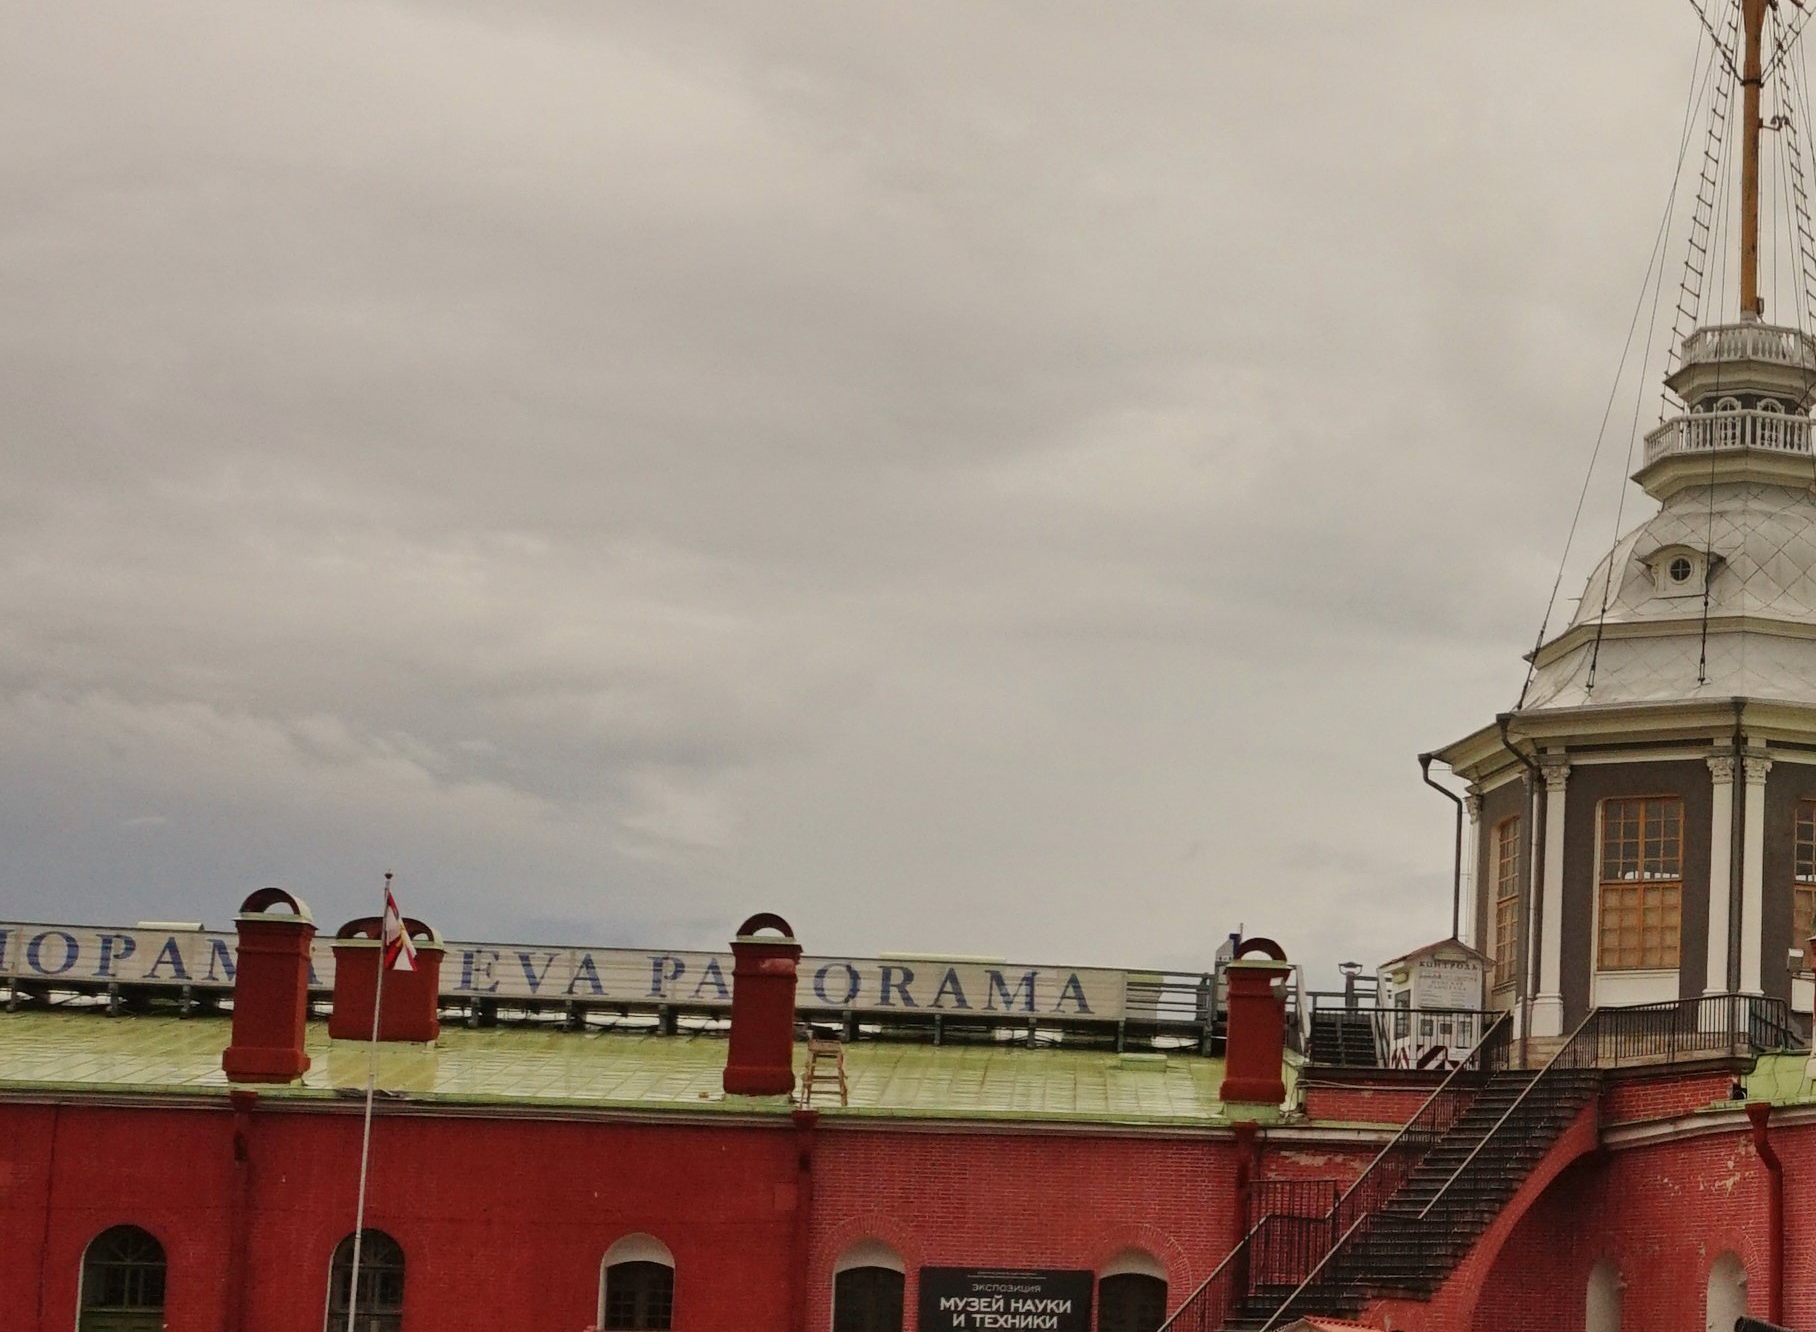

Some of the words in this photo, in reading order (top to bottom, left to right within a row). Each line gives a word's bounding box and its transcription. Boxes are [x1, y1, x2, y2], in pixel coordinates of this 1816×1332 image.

[646, 956, 1095, 1014] PAORAMA
[972, 1283, 1041, 1293] ЭКСПОЗИЦИЯ
[940, 1295, 1003, 1311] МУЗЕЙ
[1010, 1299, 1071, 1313] НАУКИ
[952, 1314, 965, 1327] И
[972, 1314, 1057, 1329] ТЕХНИКИ
